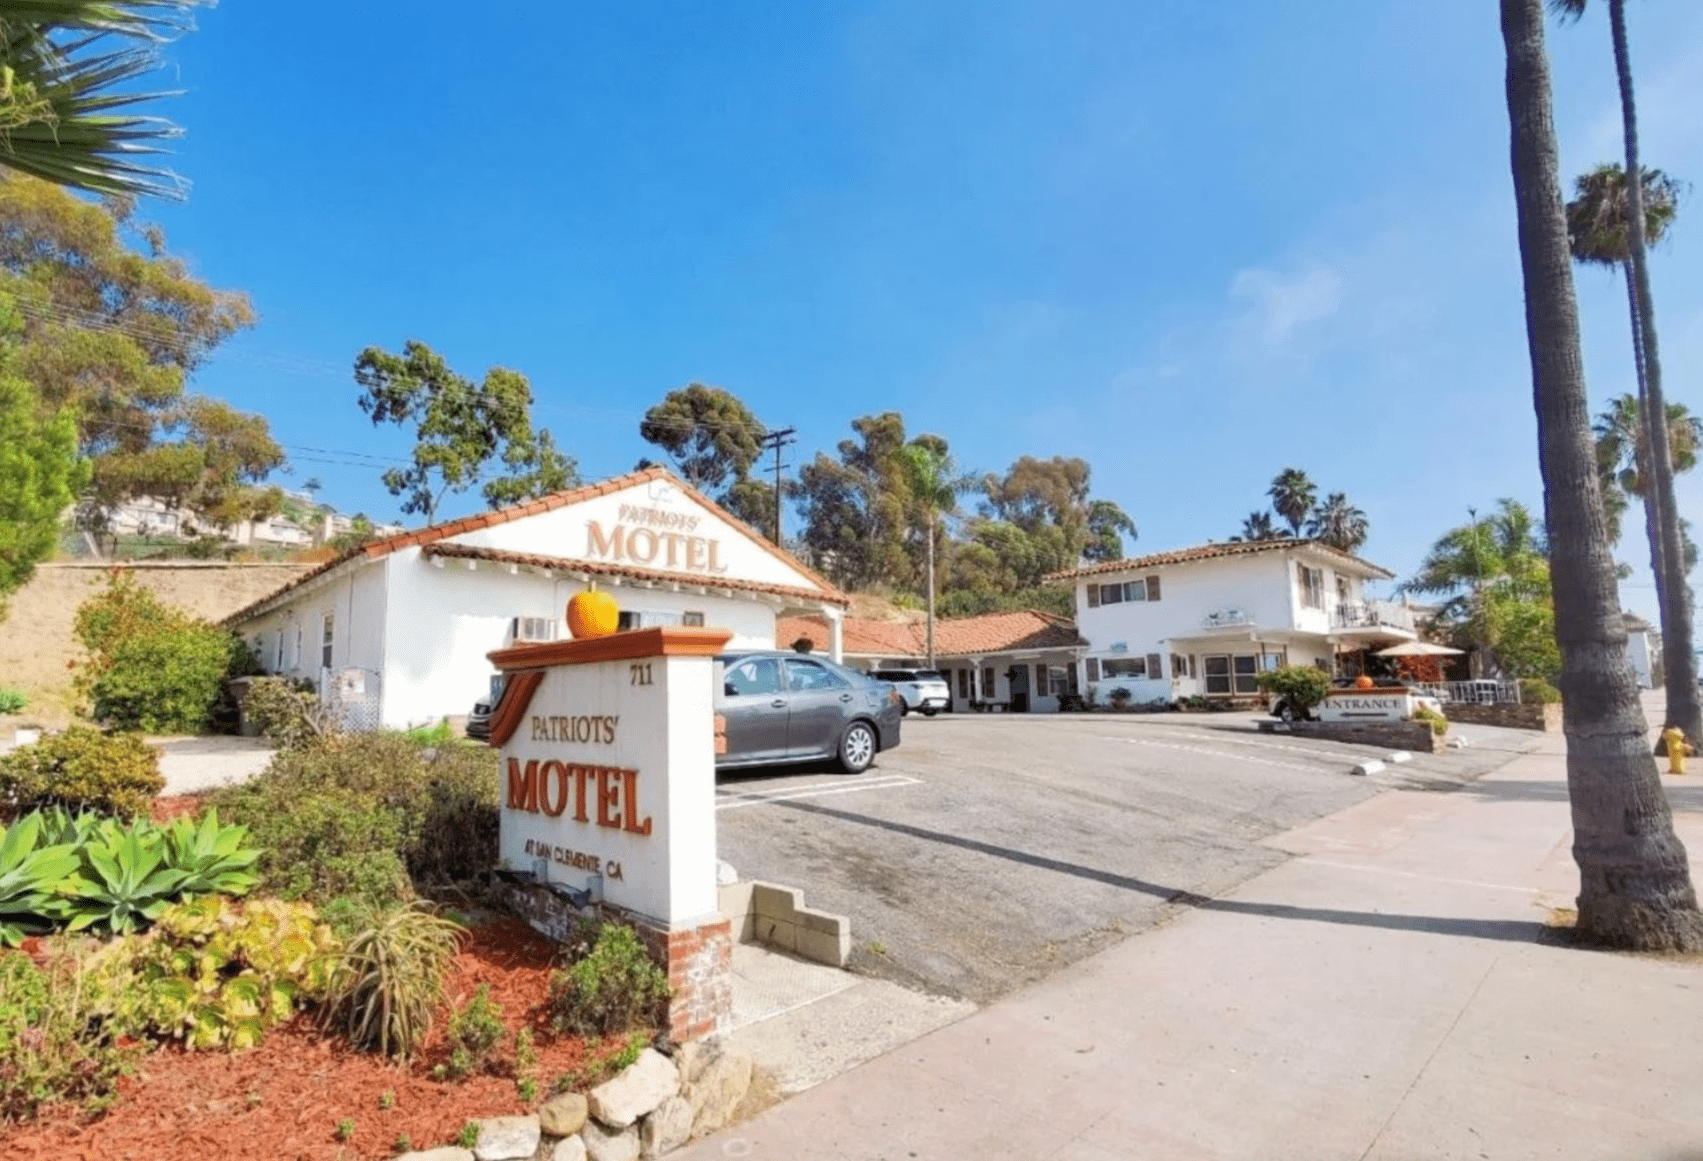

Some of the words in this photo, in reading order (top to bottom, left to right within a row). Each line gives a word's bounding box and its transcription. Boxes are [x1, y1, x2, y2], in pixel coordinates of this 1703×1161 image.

[585, 519, 728, 573] MOTEL
[629, 664, 654, 686] 711
[1324, 699, 1400, 709] ENTRANCE
[507, 757, 652, 836] MOTEL
[606, 860, 623, 881] CA
